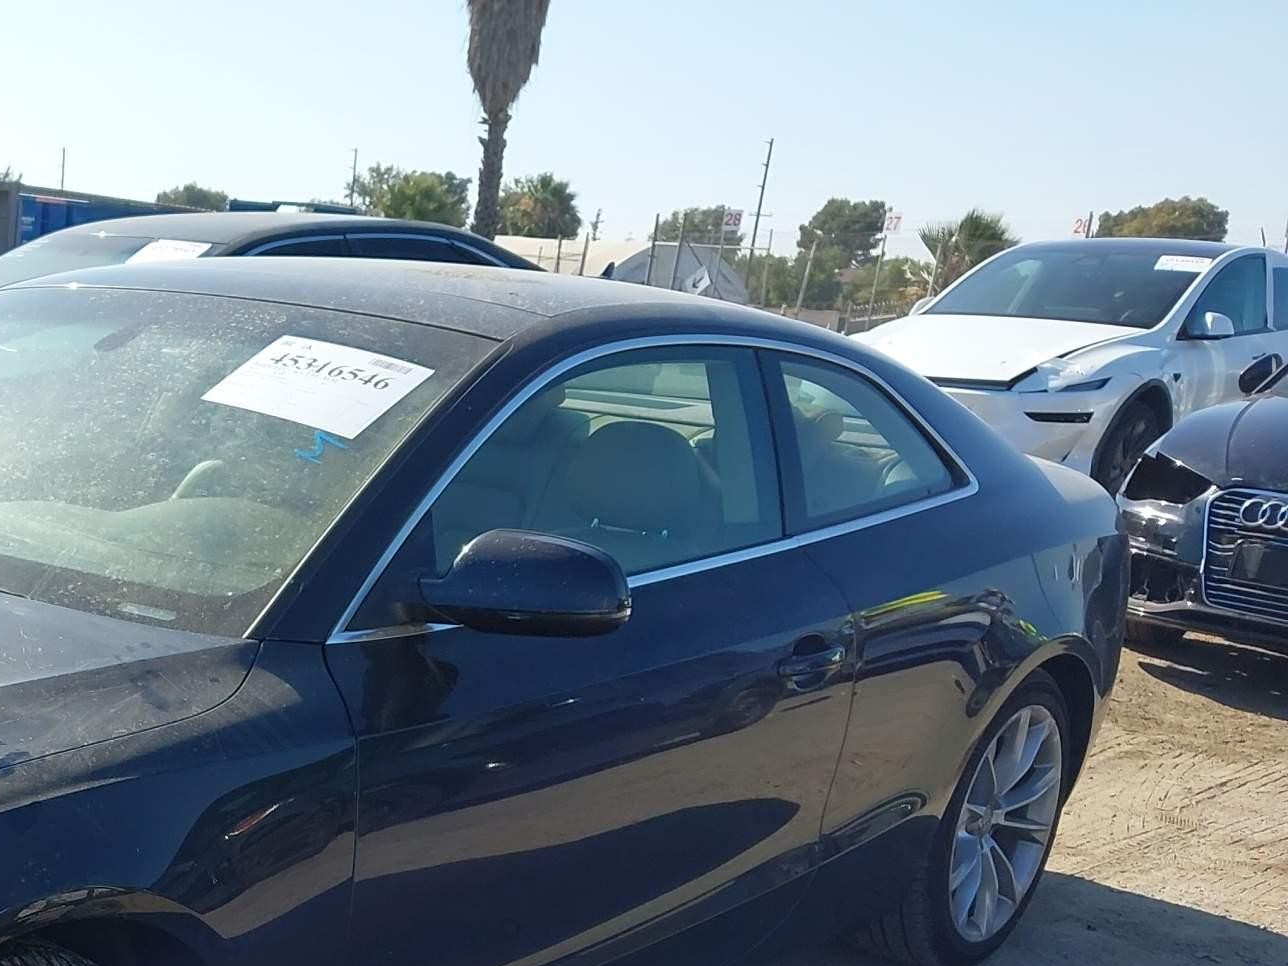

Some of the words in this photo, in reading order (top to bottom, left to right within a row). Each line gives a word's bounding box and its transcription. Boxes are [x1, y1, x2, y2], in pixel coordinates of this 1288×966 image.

[724, 212, 742, 226] 28
[885, 216, 902, 231] 27
[270, 352, 392, 390] 45316546
